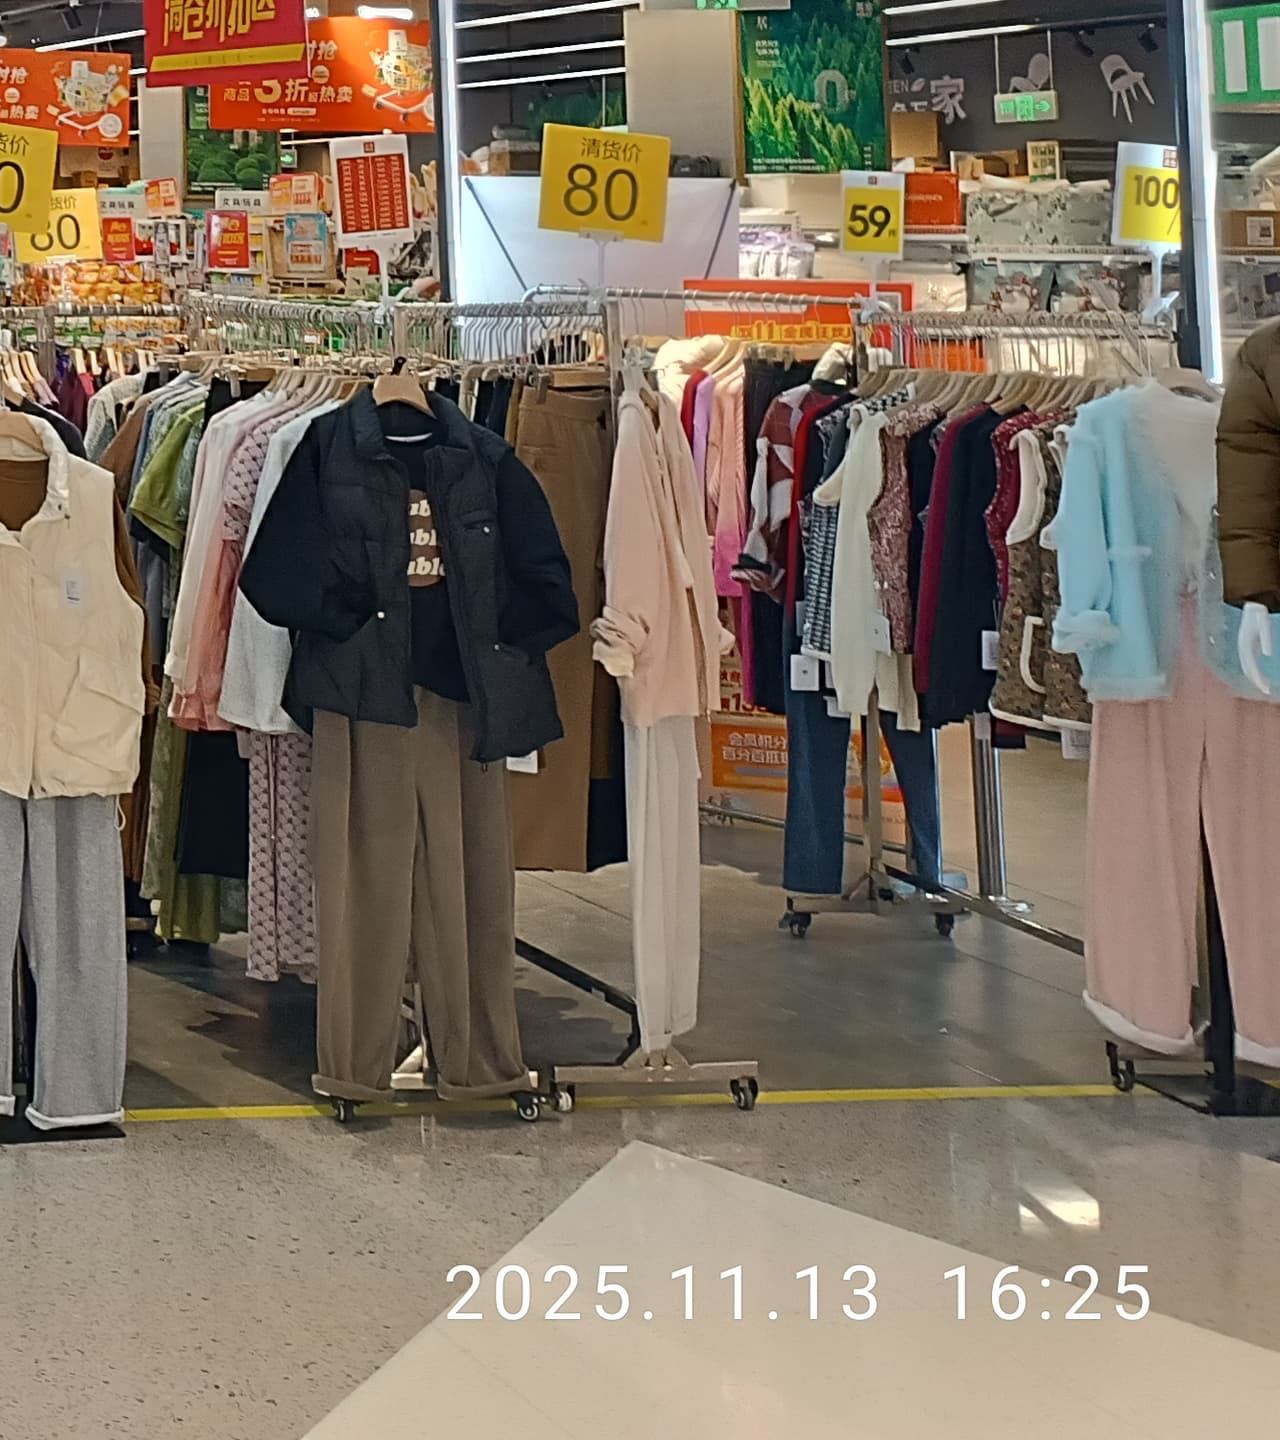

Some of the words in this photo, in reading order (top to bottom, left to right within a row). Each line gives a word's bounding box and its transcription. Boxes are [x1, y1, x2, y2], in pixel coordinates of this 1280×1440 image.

[581, 137, 642, 164] 清货价
[563, 163, 639, 222] 80
[1134, 174, 1180, 209] 100
[848, 204, 891, 238] 59
